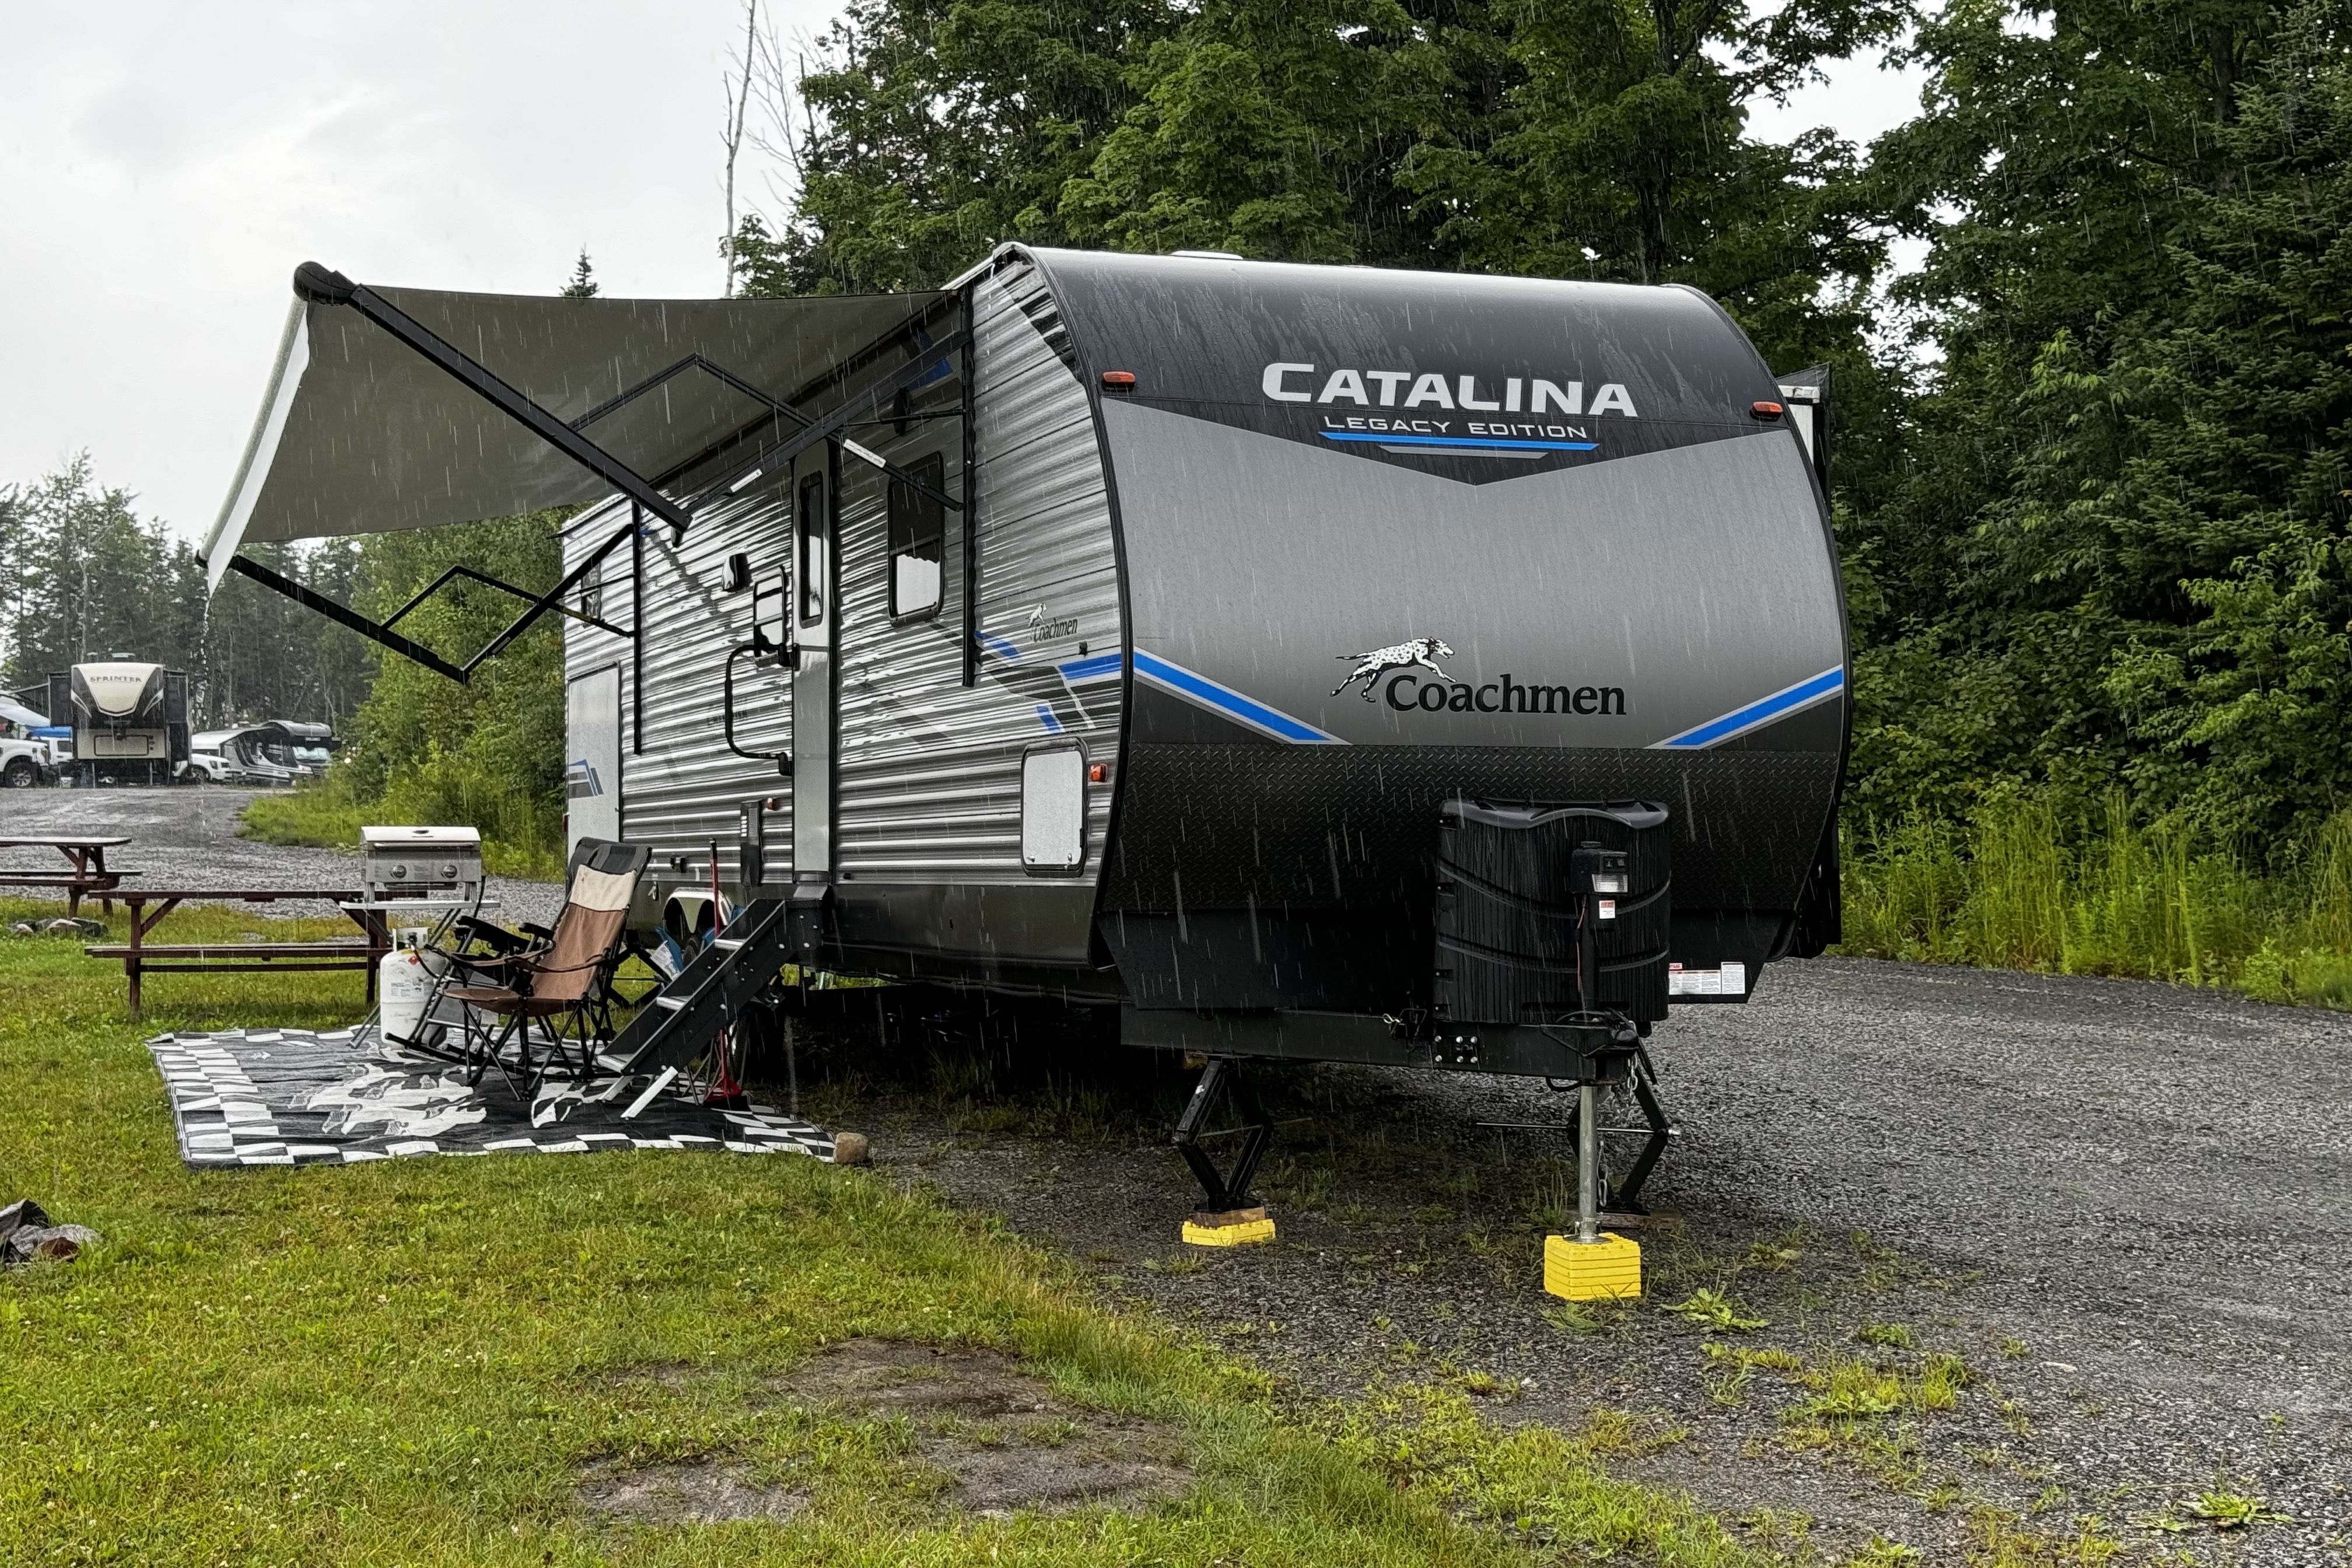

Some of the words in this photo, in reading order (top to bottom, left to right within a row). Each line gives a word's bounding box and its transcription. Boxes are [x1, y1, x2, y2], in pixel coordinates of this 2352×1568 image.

[1262, 362, 1639, 417] CATALINA
[1324, 416, 1450, 433] LEGACY
[1468, 422, 1587, 439] EDITION
[1034, 617, 1078, 643] Coachmen
[1386, 674, 1627, 716] Coachmen
